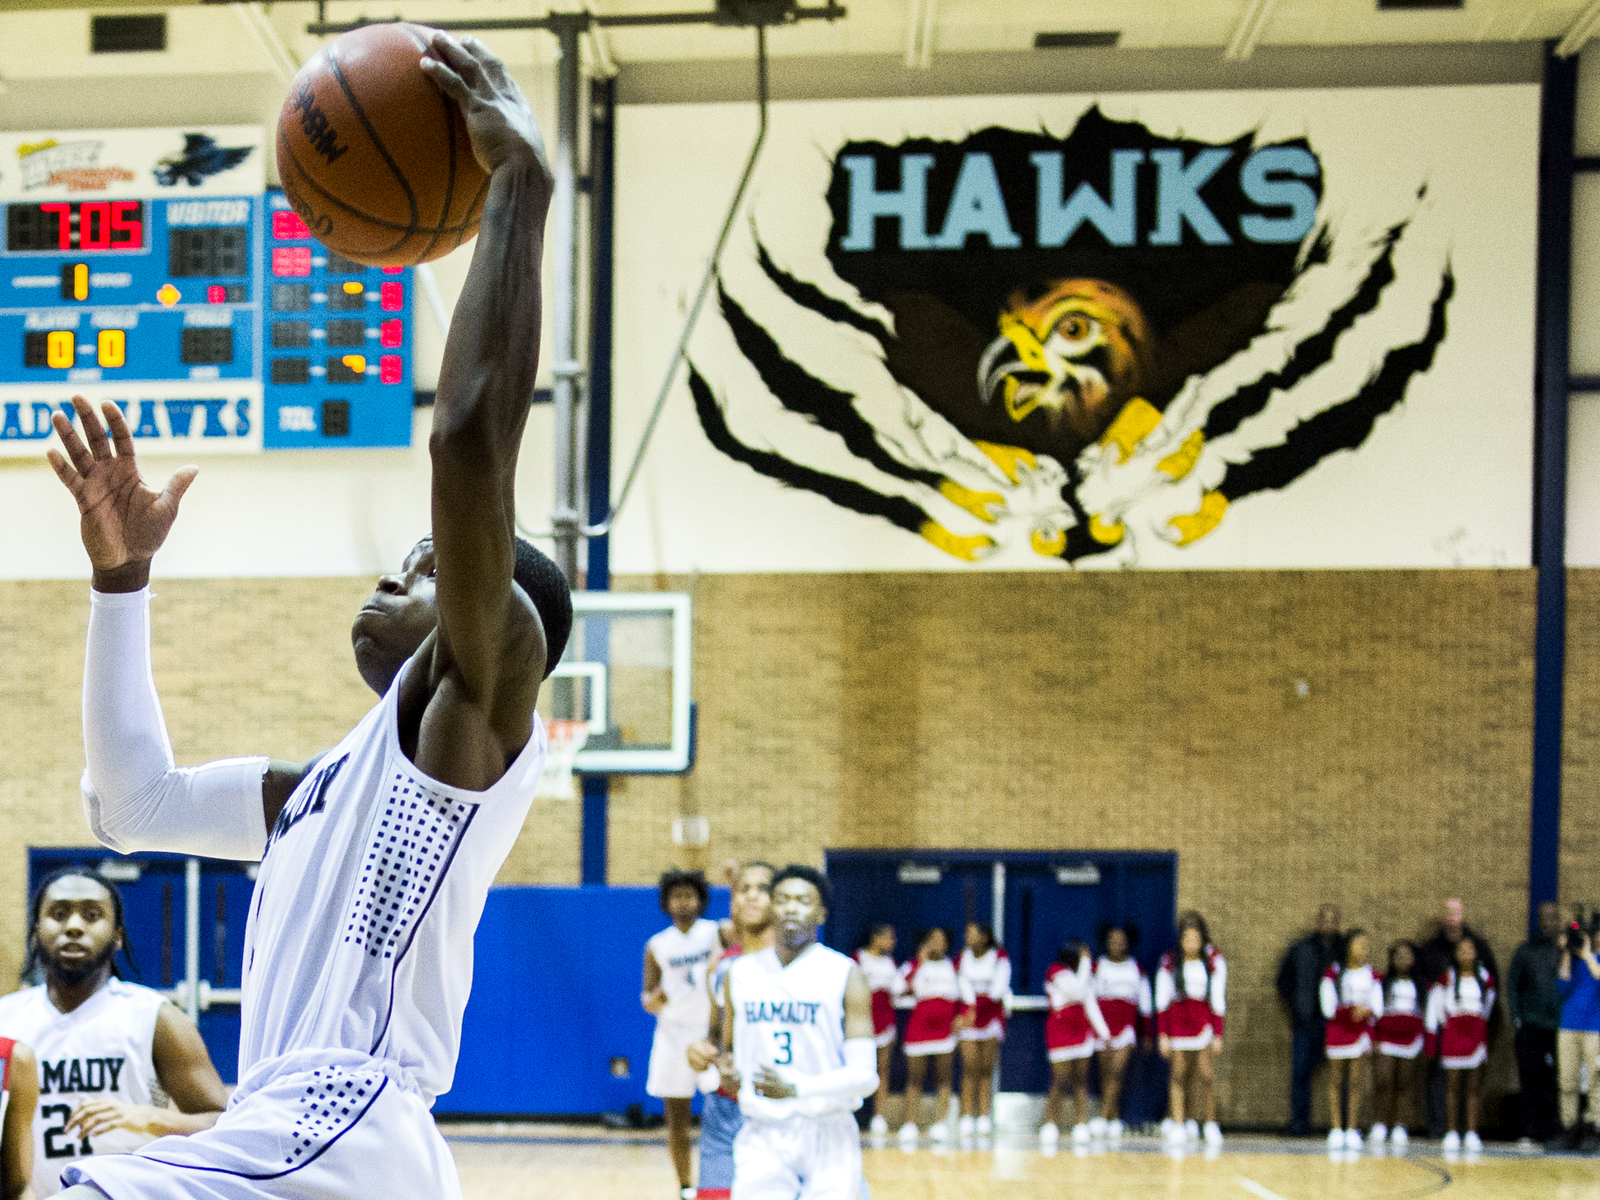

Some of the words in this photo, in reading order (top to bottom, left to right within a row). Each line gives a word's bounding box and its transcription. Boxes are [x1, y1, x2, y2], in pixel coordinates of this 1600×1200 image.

[841, 146, 1319, 250] HAWKS
[744, 1001, 820, 1025] HAMADY
[774, 1031, 793, 1066] 3
[40, 1058, 125, 1094] MADY
